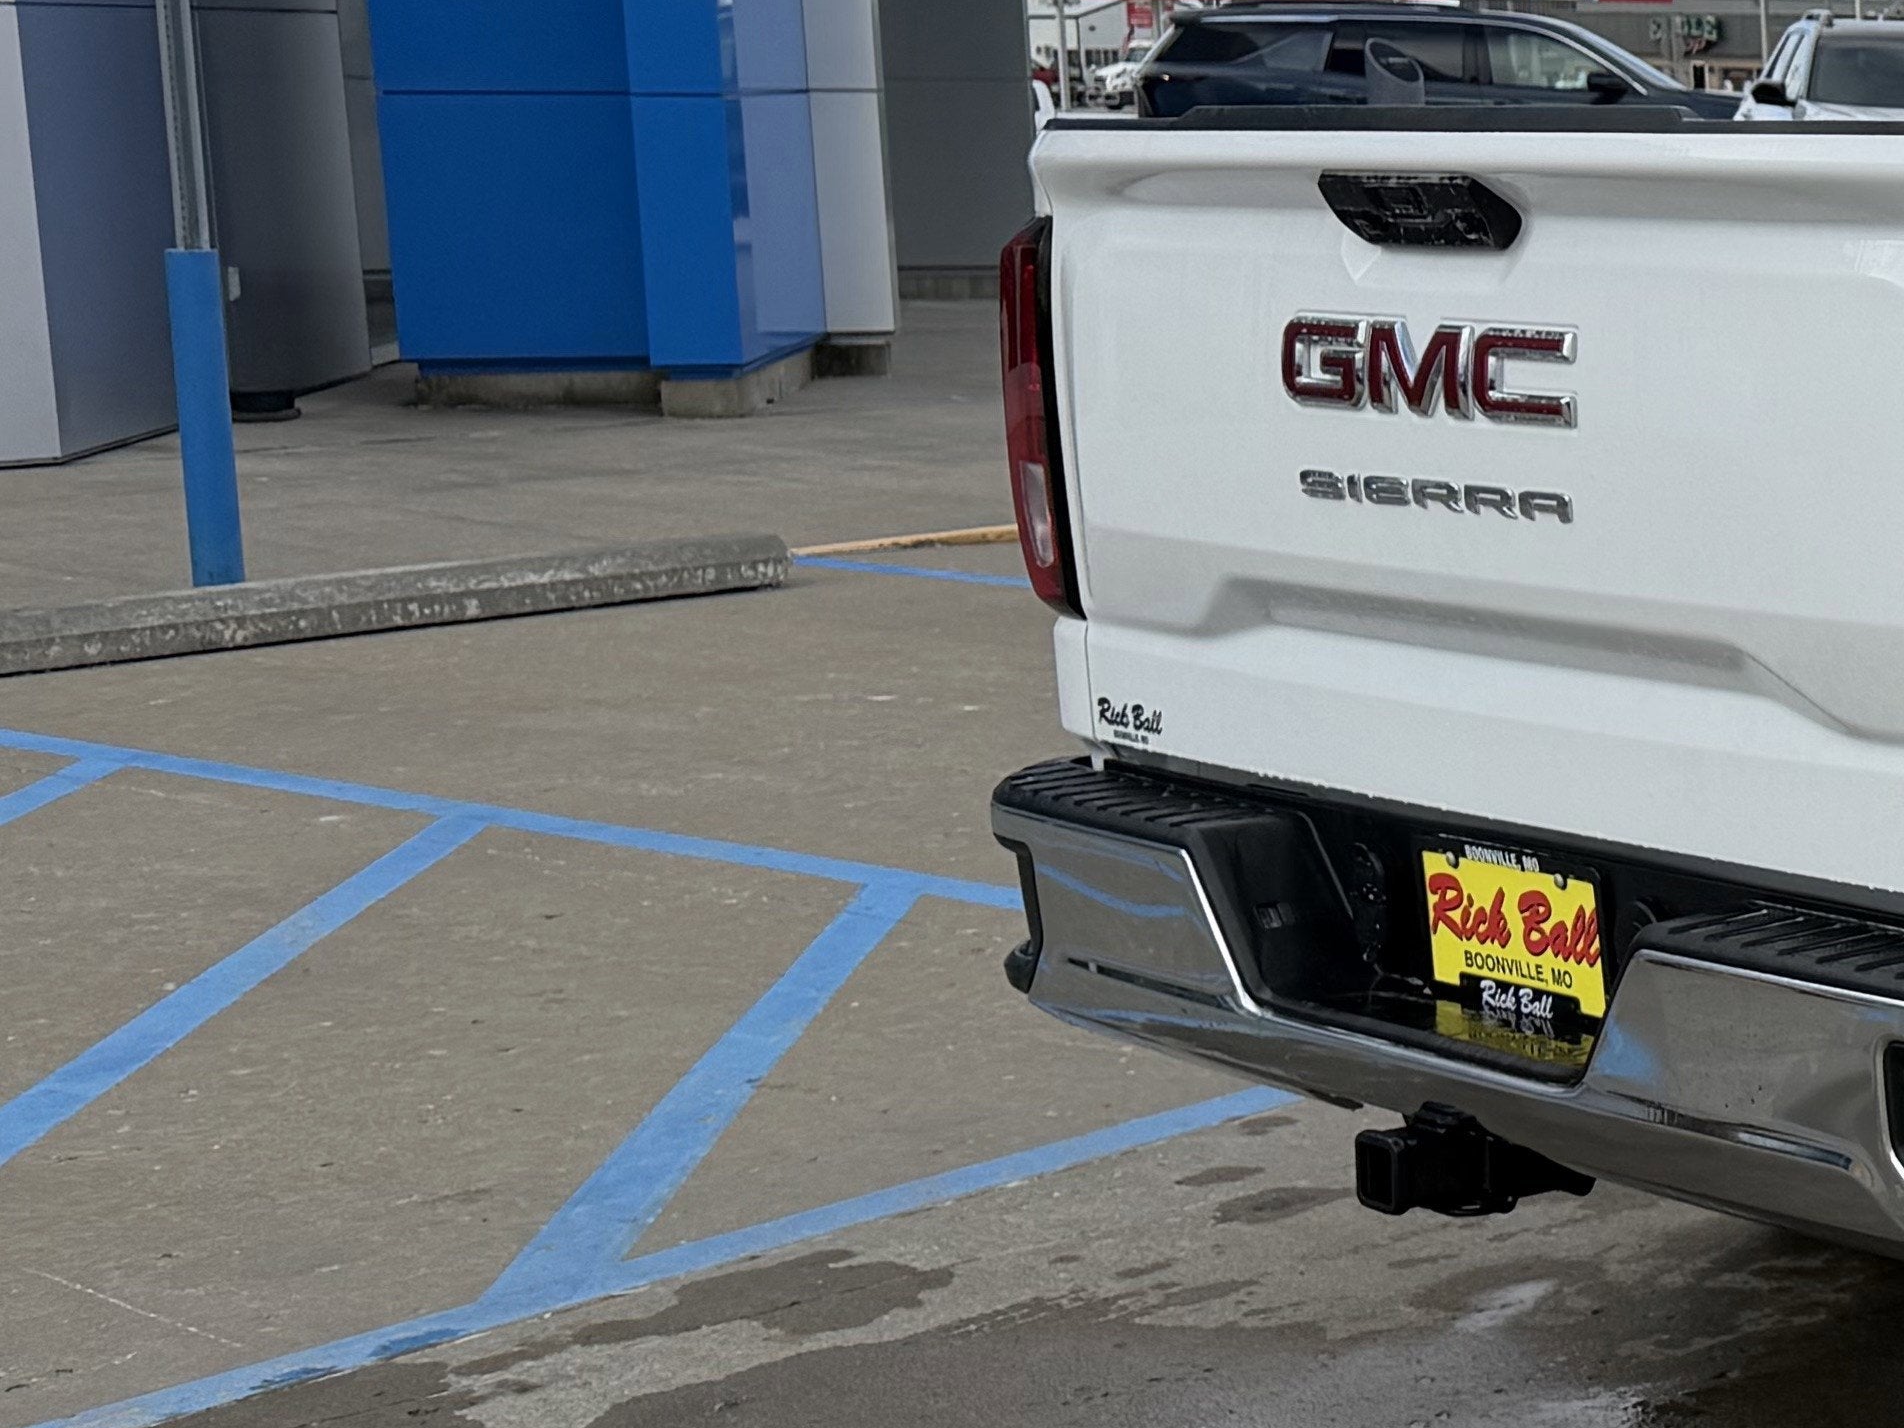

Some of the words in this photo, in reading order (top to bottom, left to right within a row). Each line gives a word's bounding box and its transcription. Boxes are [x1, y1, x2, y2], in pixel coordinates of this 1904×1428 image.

[1281, 311, 1579, 430] GMC
[1299, 468, 1574, 525] SIERRA
[1097, 696, 1131, 729] Rick
[1131, 703, 1163, 735] Ball
[1464, 844, 1522, 872] BOONVILLE,
[1522, 856, 1540, 873] MO
[1428, 872, 1512, 949] Rick
[1517, 889, 1602, 968] Ball
[1463, 949, 1550, 988] BOONVILLE,
[1551, 967, 1573, 990] MO
[1479, 979, 1518, 1012] Rick
[1518, 987, 1555, 1020] Ball
